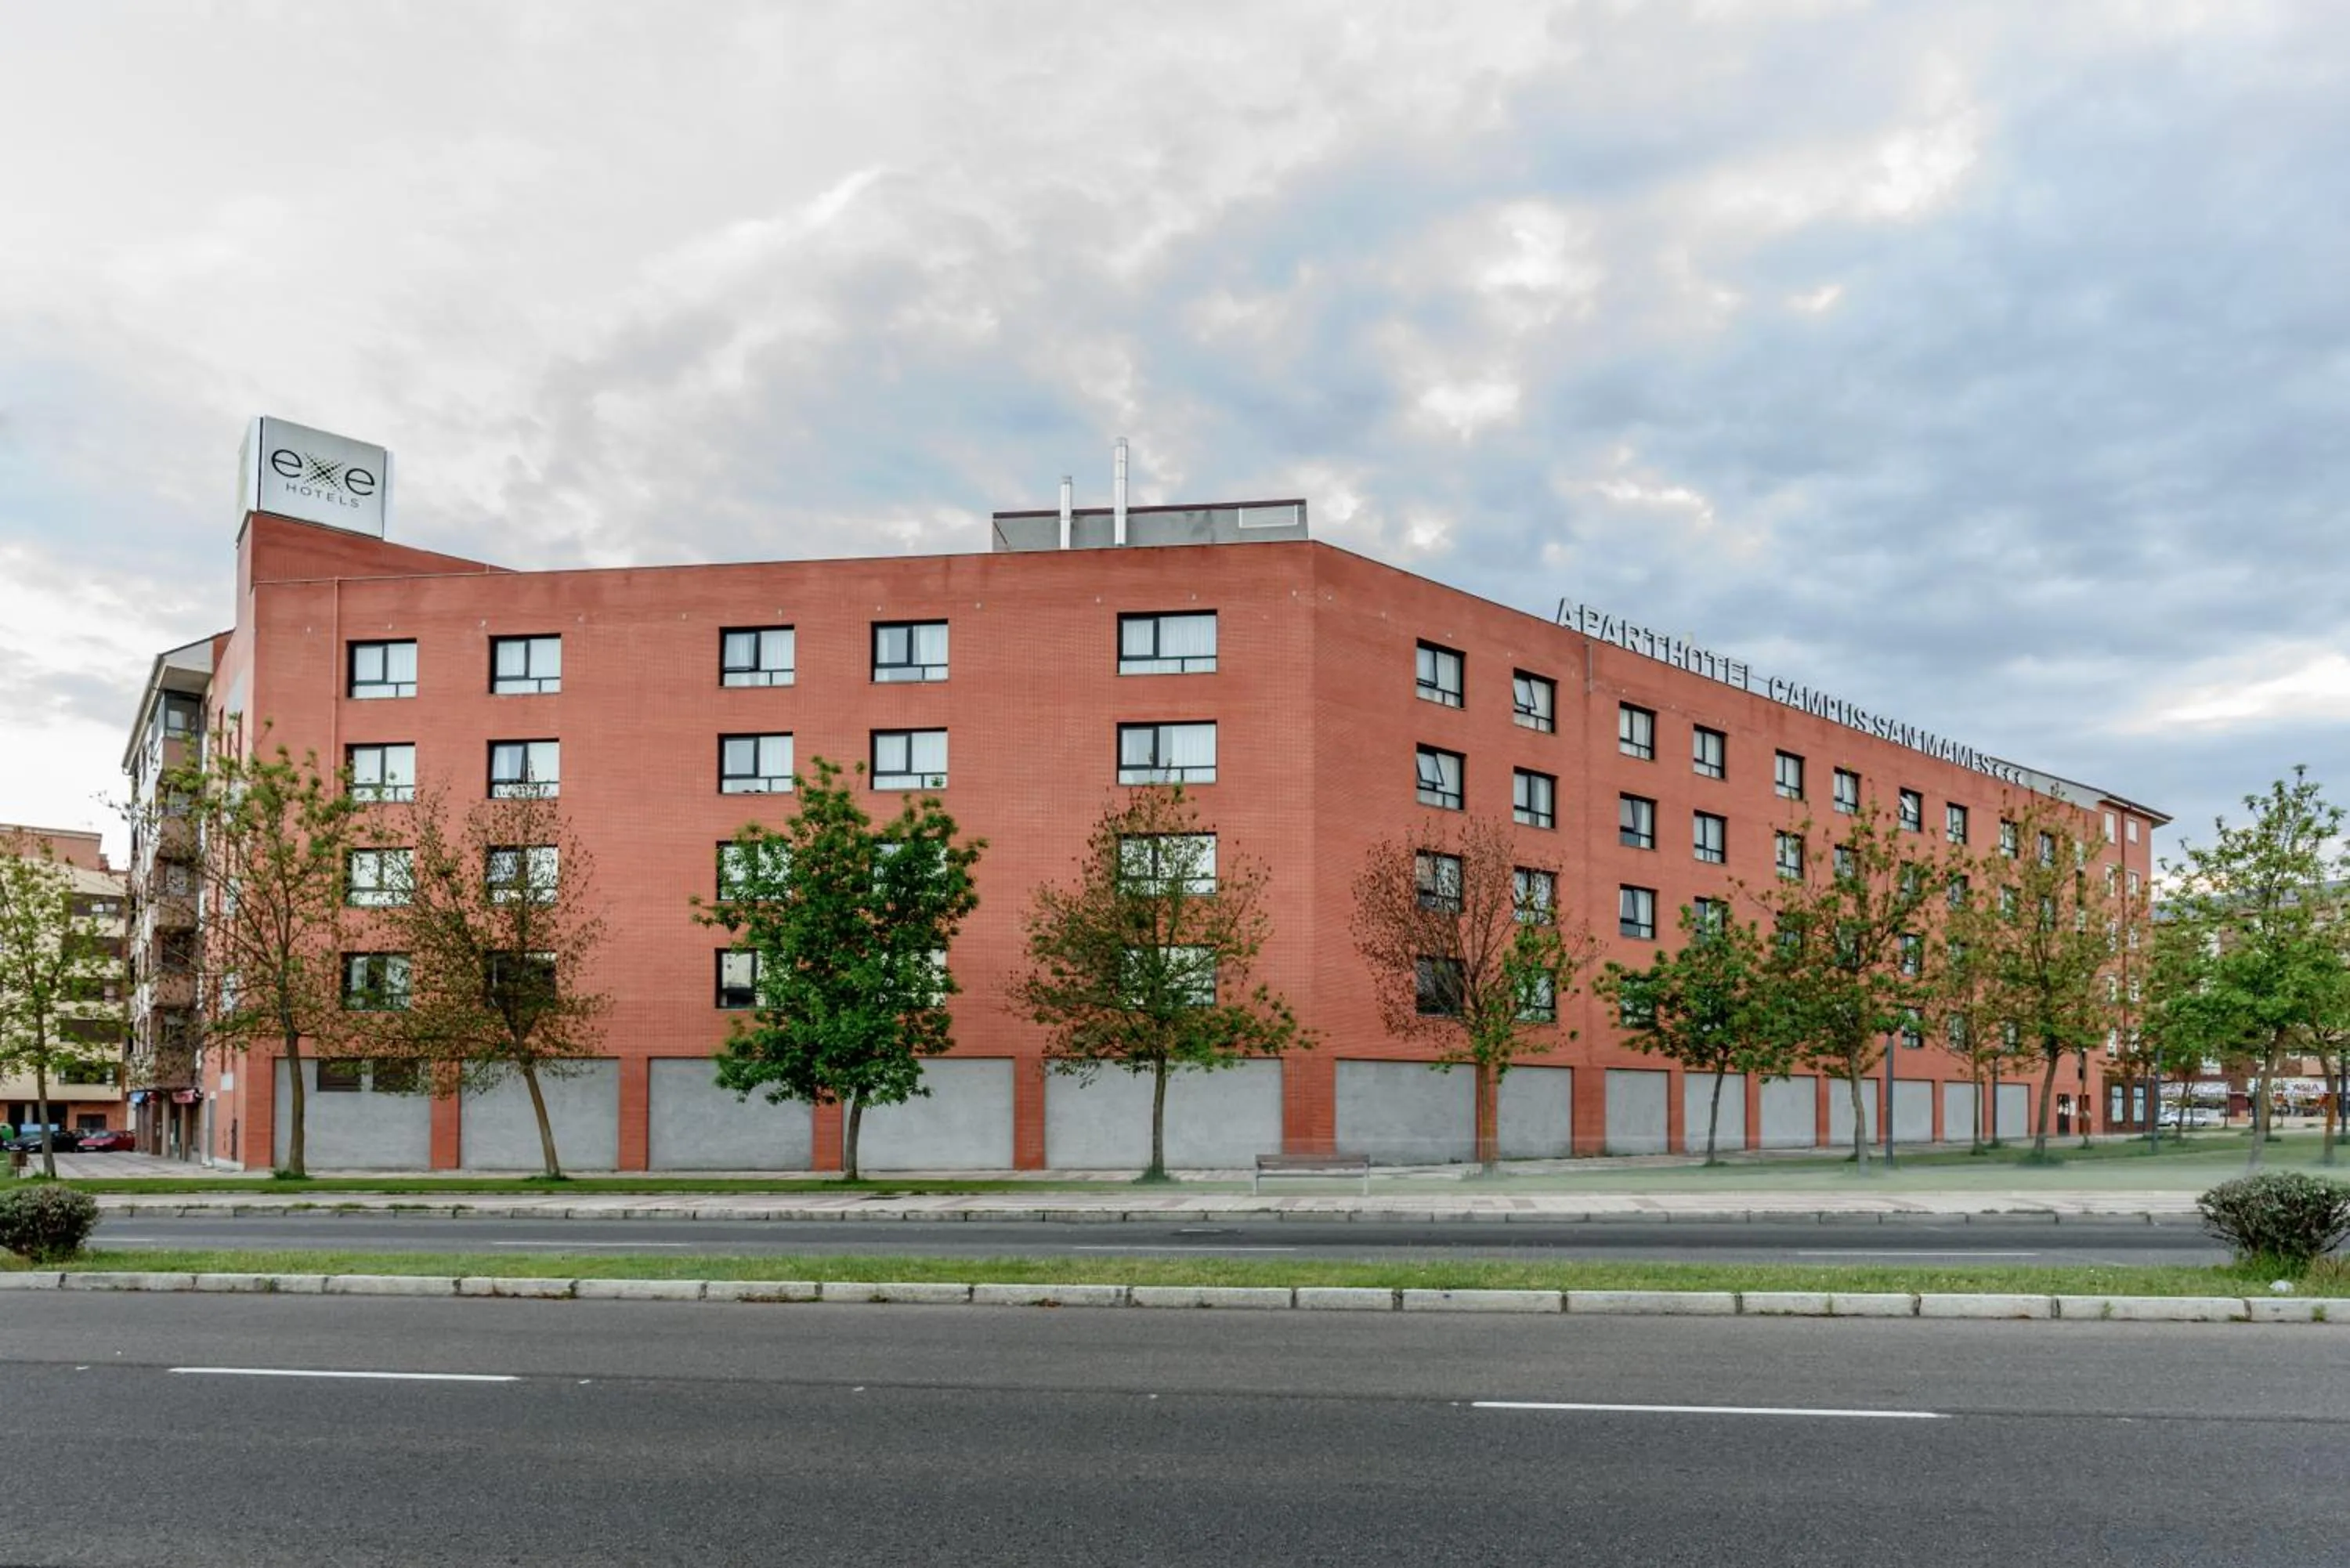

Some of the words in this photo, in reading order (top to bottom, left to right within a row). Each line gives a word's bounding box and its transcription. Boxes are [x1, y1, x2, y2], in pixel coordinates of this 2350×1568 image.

[285, 482, 360, 508] HOTELS
[1556, 598, 1755, 691] APARTHOTEL
[1769, 676, 1867, 732] CAMPUS
[1873, 714, 1918, 750] SAN
[1920, 729, 1992, 775] MAMES
